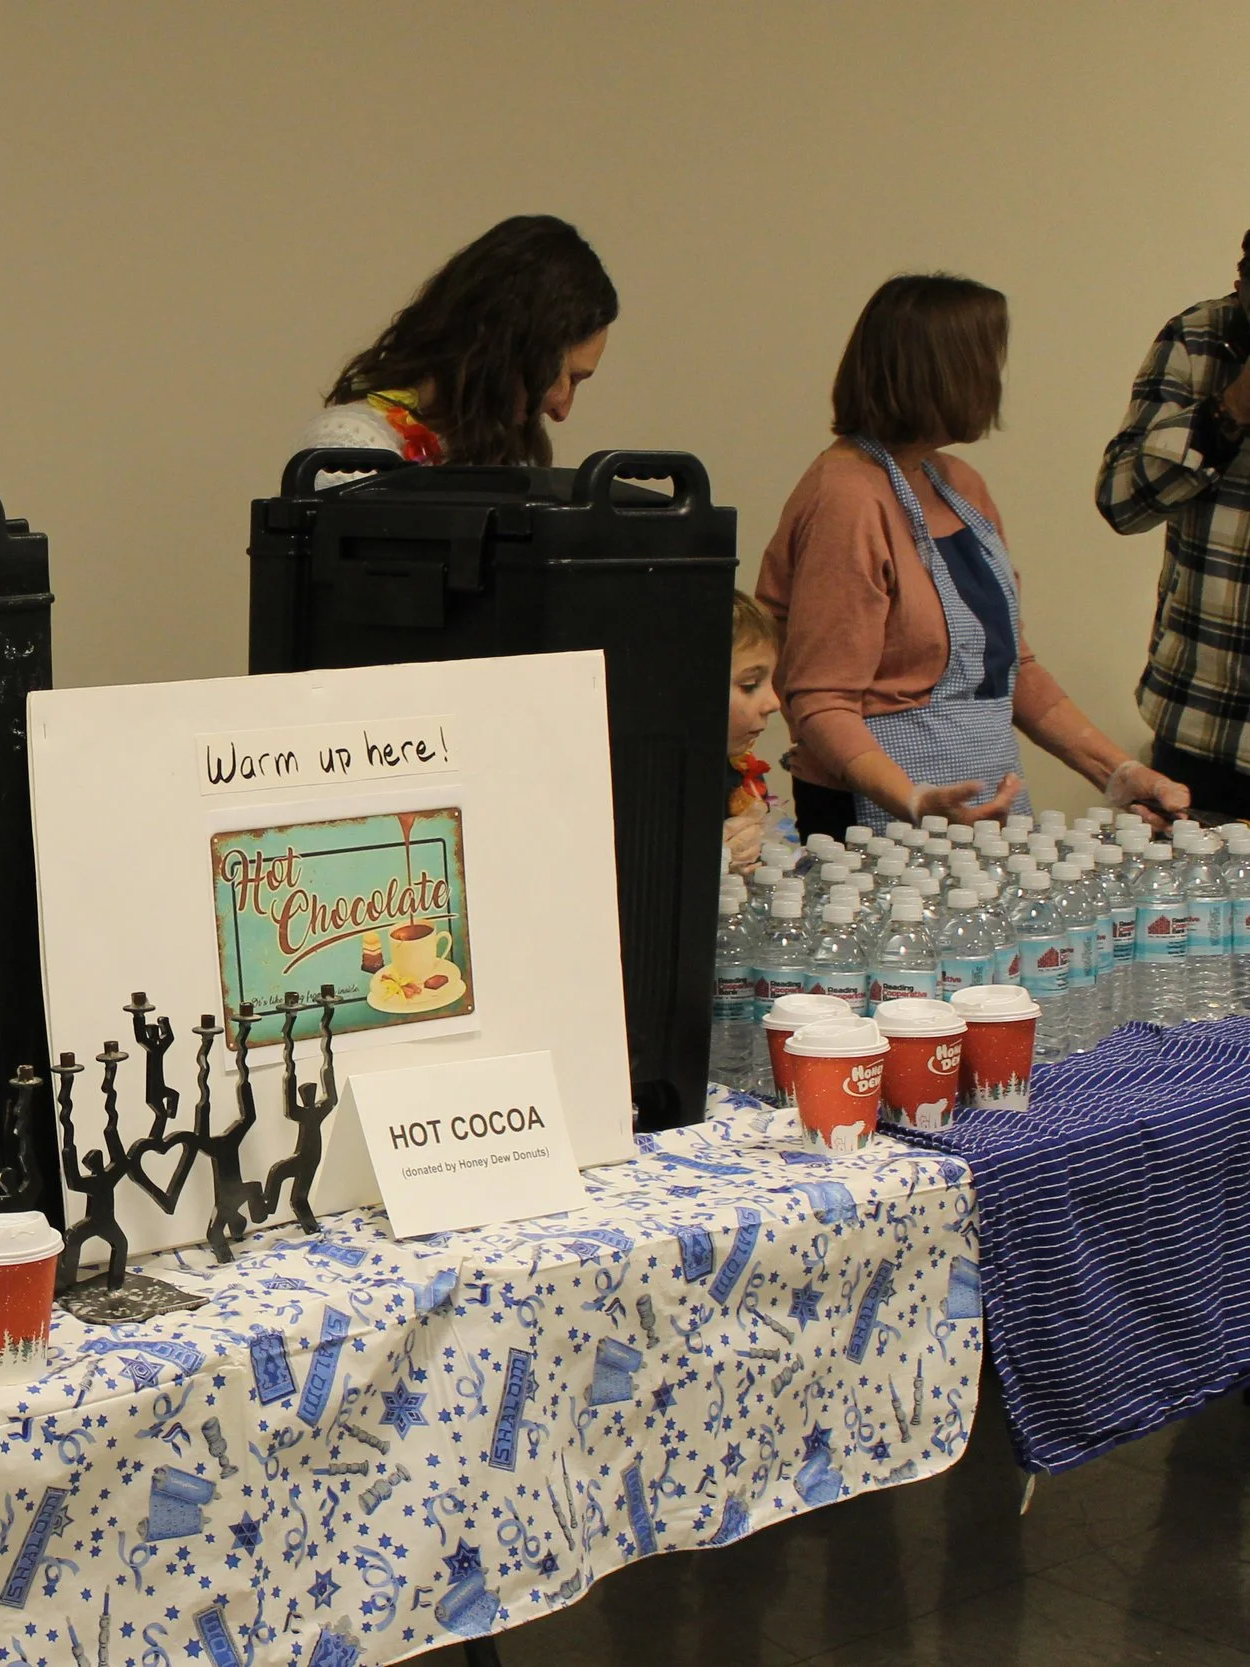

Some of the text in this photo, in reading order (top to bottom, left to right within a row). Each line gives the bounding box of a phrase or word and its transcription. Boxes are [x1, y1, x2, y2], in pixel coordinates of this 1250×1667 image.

[206, 726, 449, 785] Warm up here!
[220, 847, 301, 916] Hot
[271, 871, 450, 956] Chocolate
[388, 1105, 546, 1150] HOT COCOA
[401, 1146, 550, 1180] (donated by Honey Dew Donuts)
[493, 1355, 528, 1465] SHALOM
[6, 1492, 60, 1601] SHALOM
